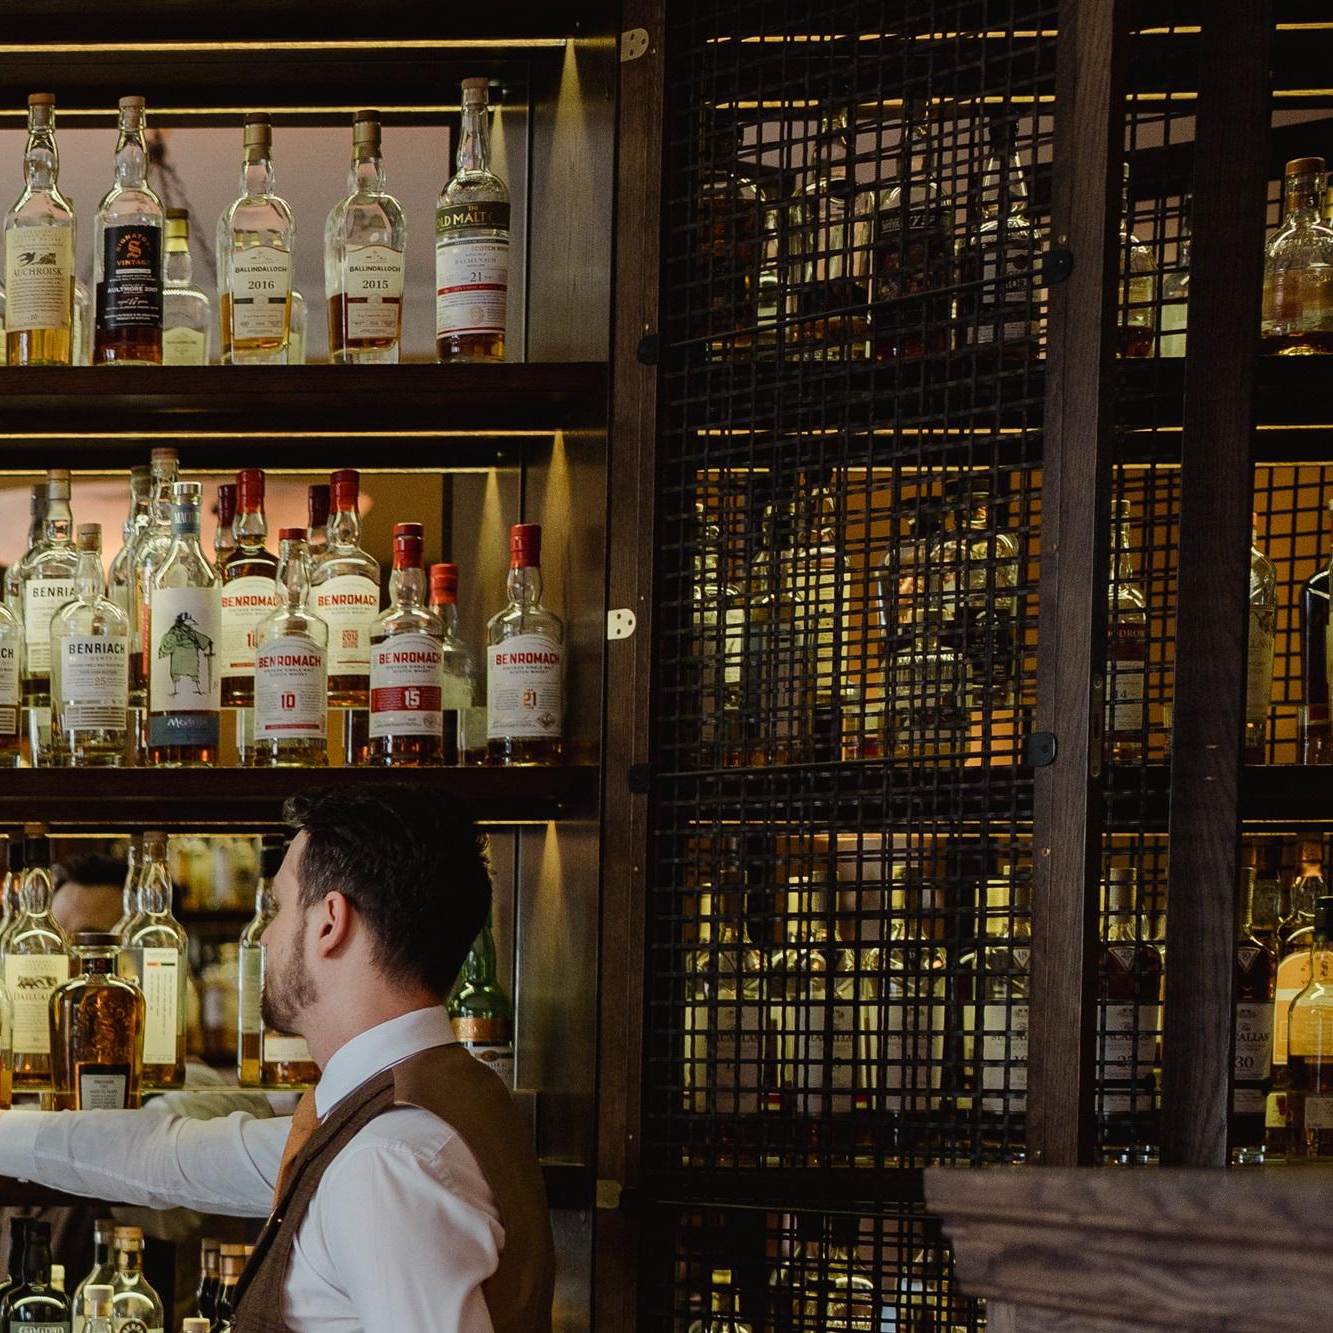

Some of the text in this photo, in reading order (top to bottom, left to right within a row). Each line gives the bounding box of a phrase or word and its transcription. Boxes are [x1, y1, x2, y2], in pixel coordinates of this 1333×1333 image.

[13, 267, 62, 276] AUCHROISK
[235, 265, 288, 274] BALLINDALLOCH
[349, 265, 401, 274] BALLINDALLOCH
[470, 271, 483, 283] 21
[248, 280, 275, 290] 2016
[362, 279, 389, 289] 2015
[32, 587, 75, 598] BENRIA
[221, 595, 278, 607] BENROMA
[317, 595, 378, 607] BENROMACH
[68, 643, 125, 655] BENRIACH
[258, 655, 321, 668] BENROMACH
[378, 652, 443, 665] BENROMACH
[495, 653, 560, 665] BENROMACH
[281, 693, 296, 709] 10
[404, 690, 421, 706] 15
[522, 691, 537, 707] 21
